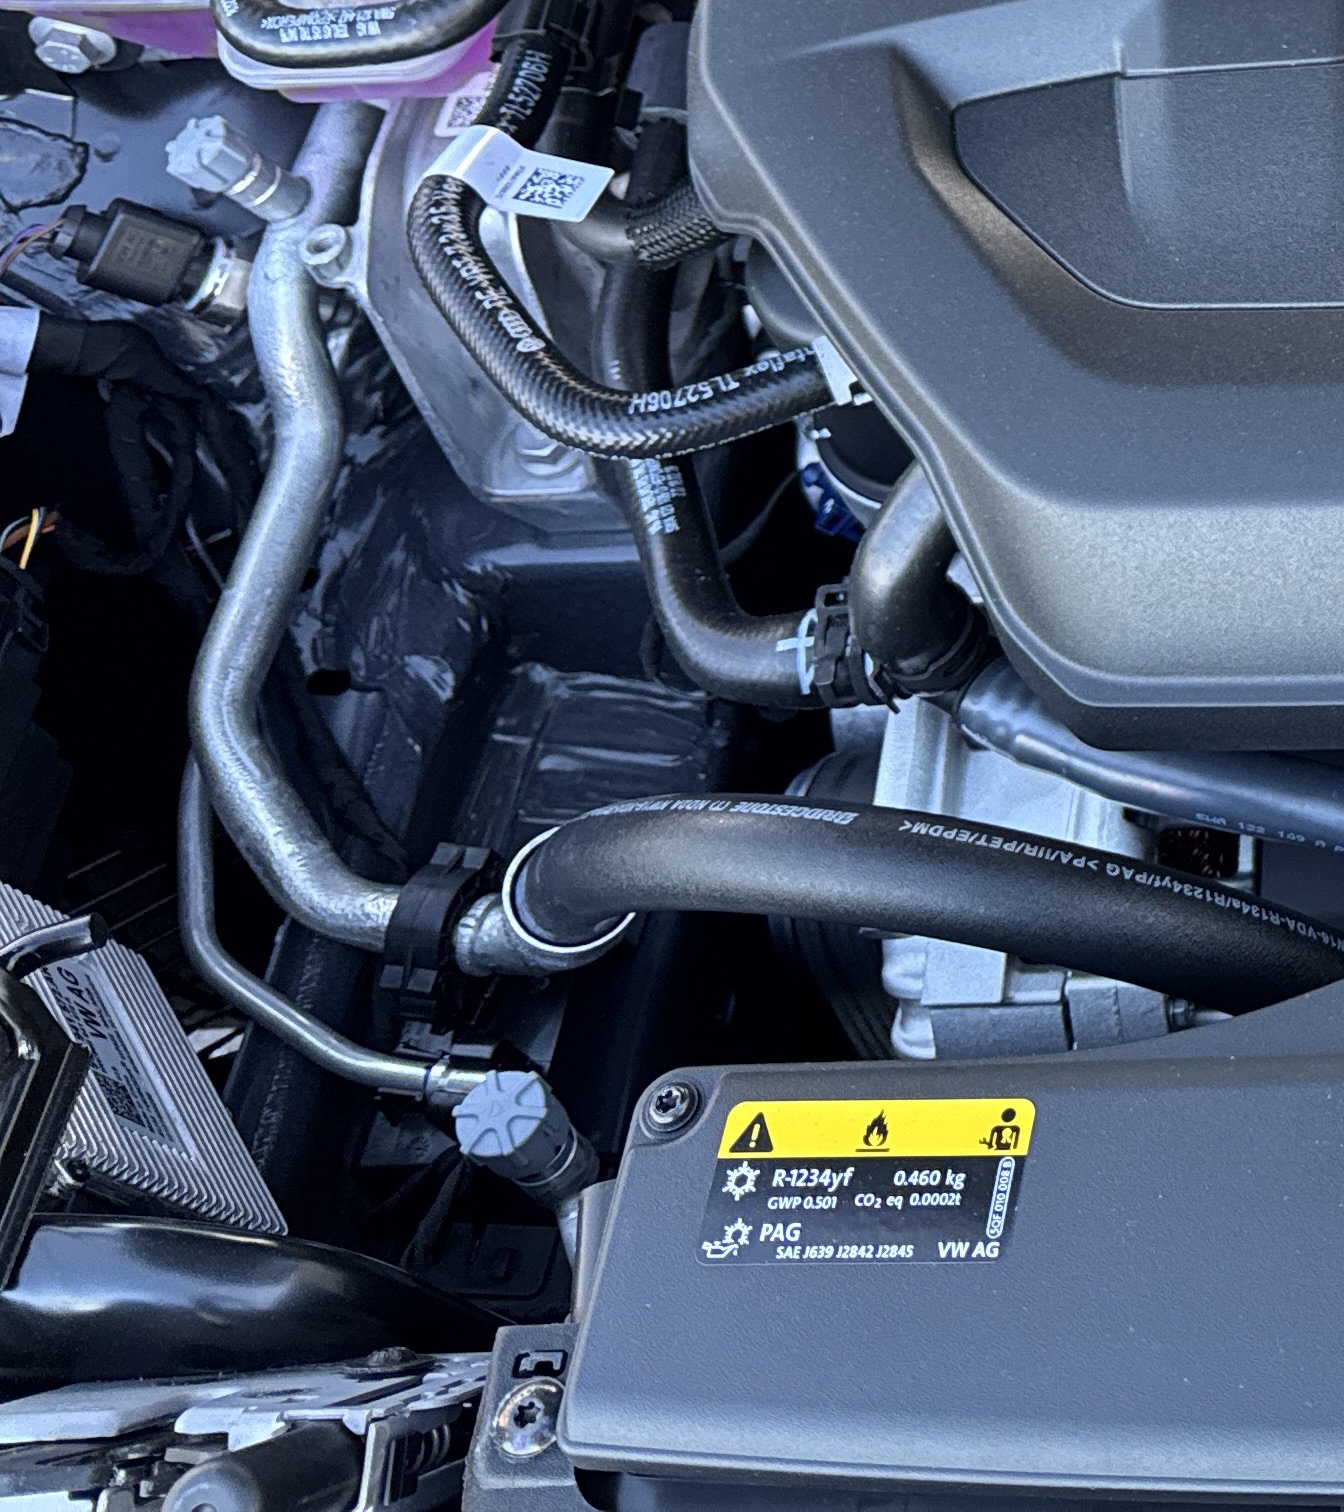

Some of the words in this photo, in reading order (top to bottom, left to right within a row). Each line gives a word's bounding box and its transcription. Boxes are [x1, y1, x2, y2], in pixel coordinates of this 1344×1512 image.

[629, 373, 739, 414] TL52706H
[58, 967, 89, 1004] AG
[75, 1001, 107, 1039] VW
[772, 1166, 854, 1189] R-1234yf
[894, 1169, 941, 1185] 0.460
[945, 1168, 966, 1189] kg
[768, 1196, 802, 1209] GWP
[803, 1195, 837, 1209] 0.501
[886, 1195, 903, 1209] eq
[910, 1192, 961, 1206] 0.0002t
[760, 1222, 801, 1241] PAG
[776, 1245, 802, 1259] SAE
[802, 1245, 834, 1259] J639
[836, 1244, 874, 1258] J2842
[875, 1244, 914, 1258] J2845
[938, 1241, 970, 1258] VW
[971, 1241, 1000, 1257] AG
